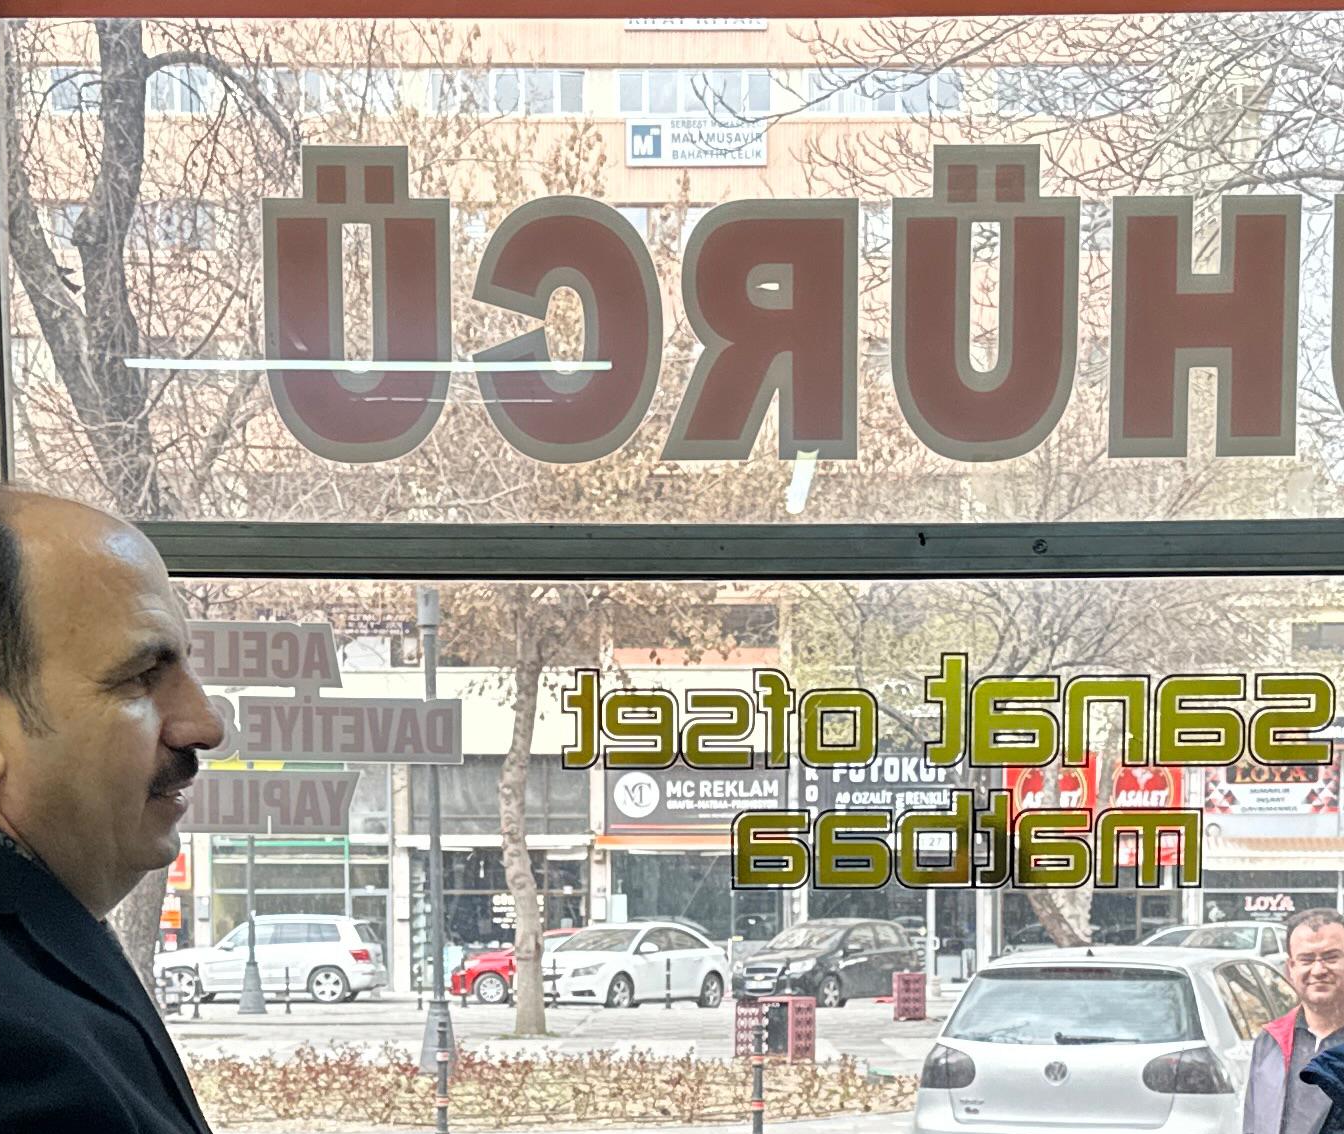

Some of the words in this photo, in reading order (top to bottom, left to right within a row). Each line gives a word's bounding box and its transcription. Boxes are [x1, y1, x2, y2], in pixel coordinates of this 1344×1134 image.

[666, 780, 696, 798] MC
[699, 779, 780, 798] REKLAM
[1022, 788, 1082, 808] ASET
[1244, 895, 1295, 912] LOYA
